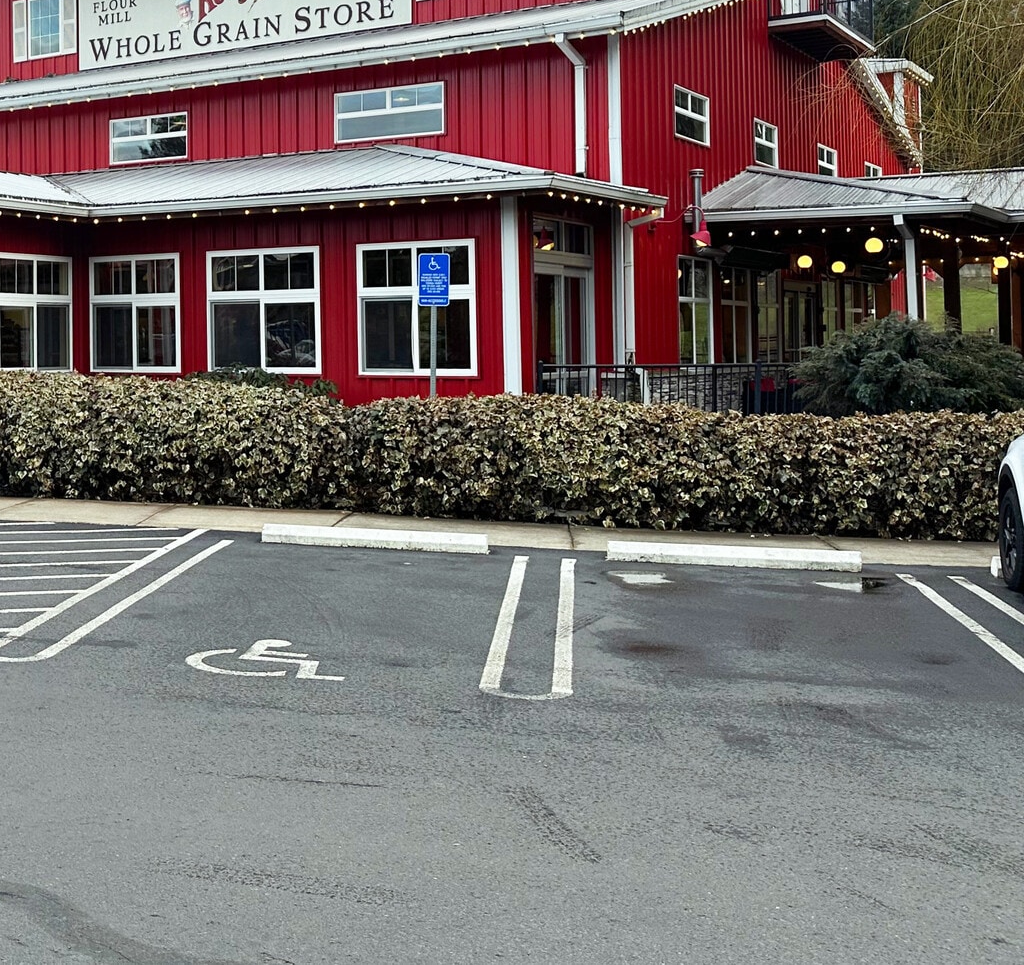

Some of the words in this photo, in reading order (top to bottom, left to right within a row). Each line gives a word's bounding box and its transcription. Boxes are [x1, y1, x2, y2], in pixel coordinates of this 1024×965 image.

[98, 11, 132, 27] MILL
[90, 30, 182, 62] WHOLE
[193, 14, 282, 47] GRAIN
